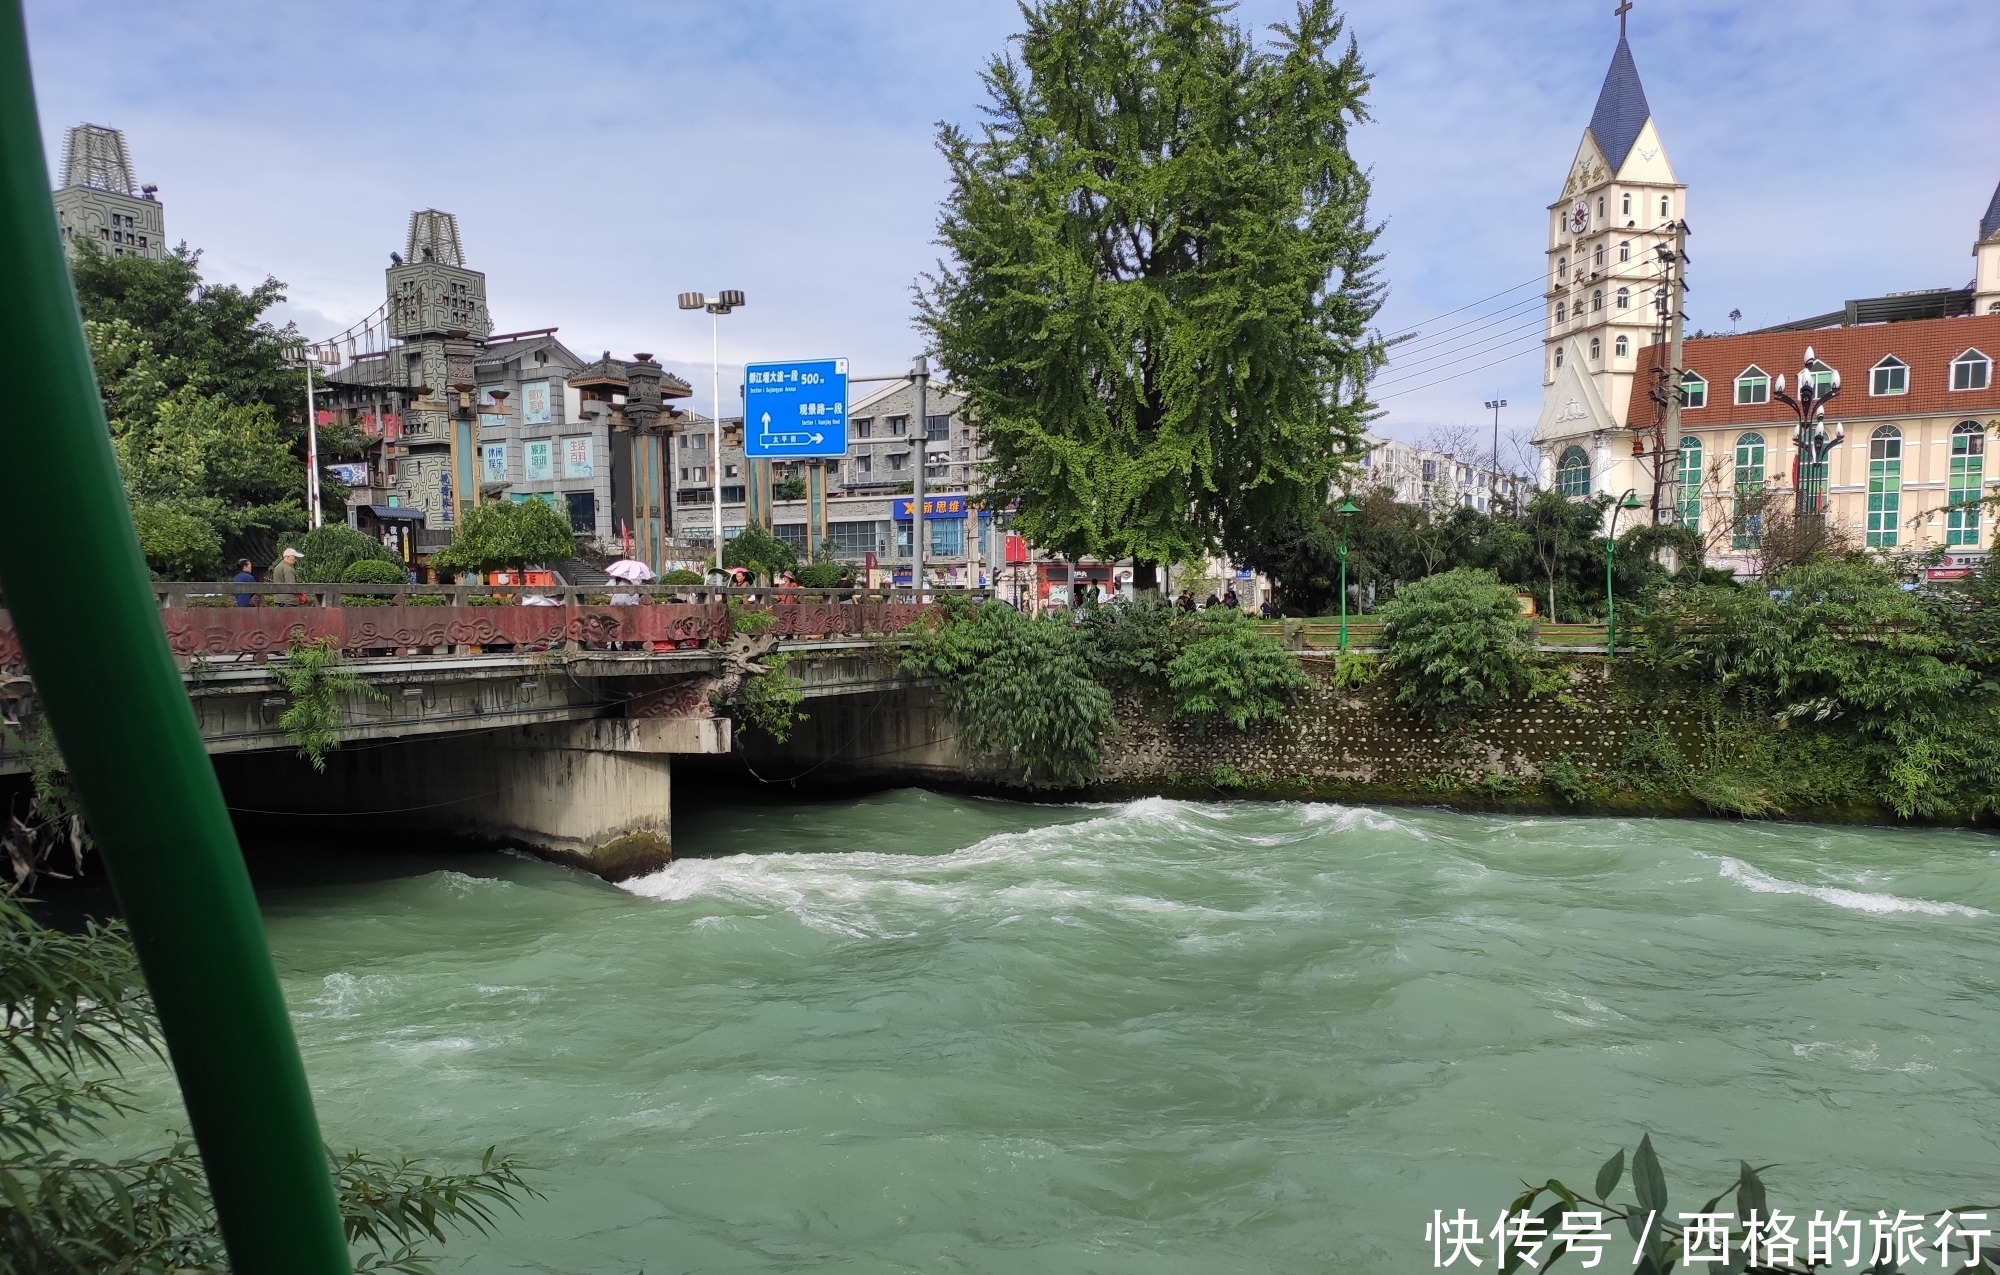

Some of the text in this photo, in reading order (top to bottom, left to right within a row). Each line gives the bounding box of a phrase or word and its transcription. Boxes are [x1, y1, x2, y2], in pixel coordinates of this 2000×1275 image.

[748, 370, 798, 384] 都江堰大道一段
[799, 402, 843, 416] 观景路一段
[531, 444, 546, 455] 旅游
[570, 440, 586, 451] 生活
[488, 447, 503, 458] 休闲
[570, 452, 586, 463] 百科
[488, 458, 503, 469] 娱乐
[531, 455, 547, 467] 培训
